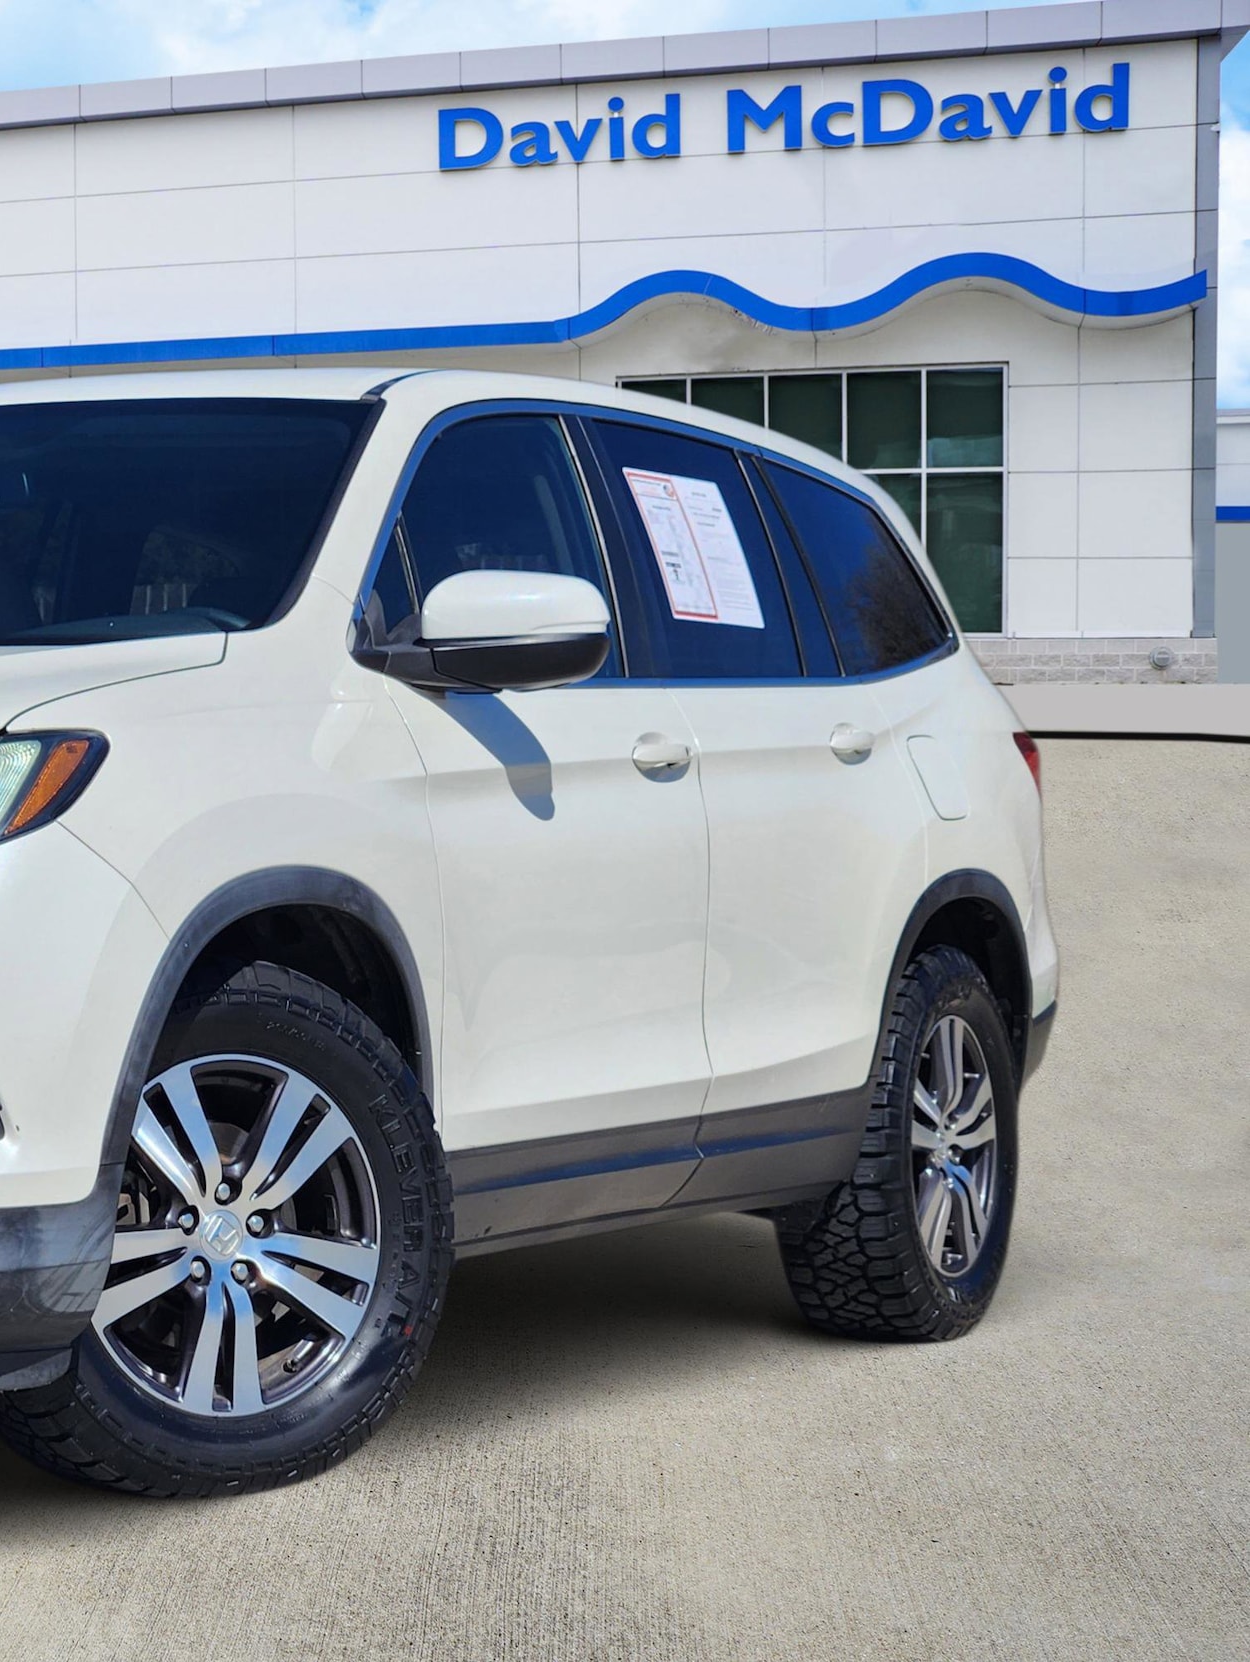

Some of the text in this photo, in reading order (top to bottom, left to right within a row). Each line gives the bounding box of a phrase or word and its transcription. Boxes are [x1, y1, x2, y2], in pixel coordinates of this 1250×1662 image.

[438, 62, 1130, 171] David McDavid
[368, 1093, 425, 1252] KLEVER
